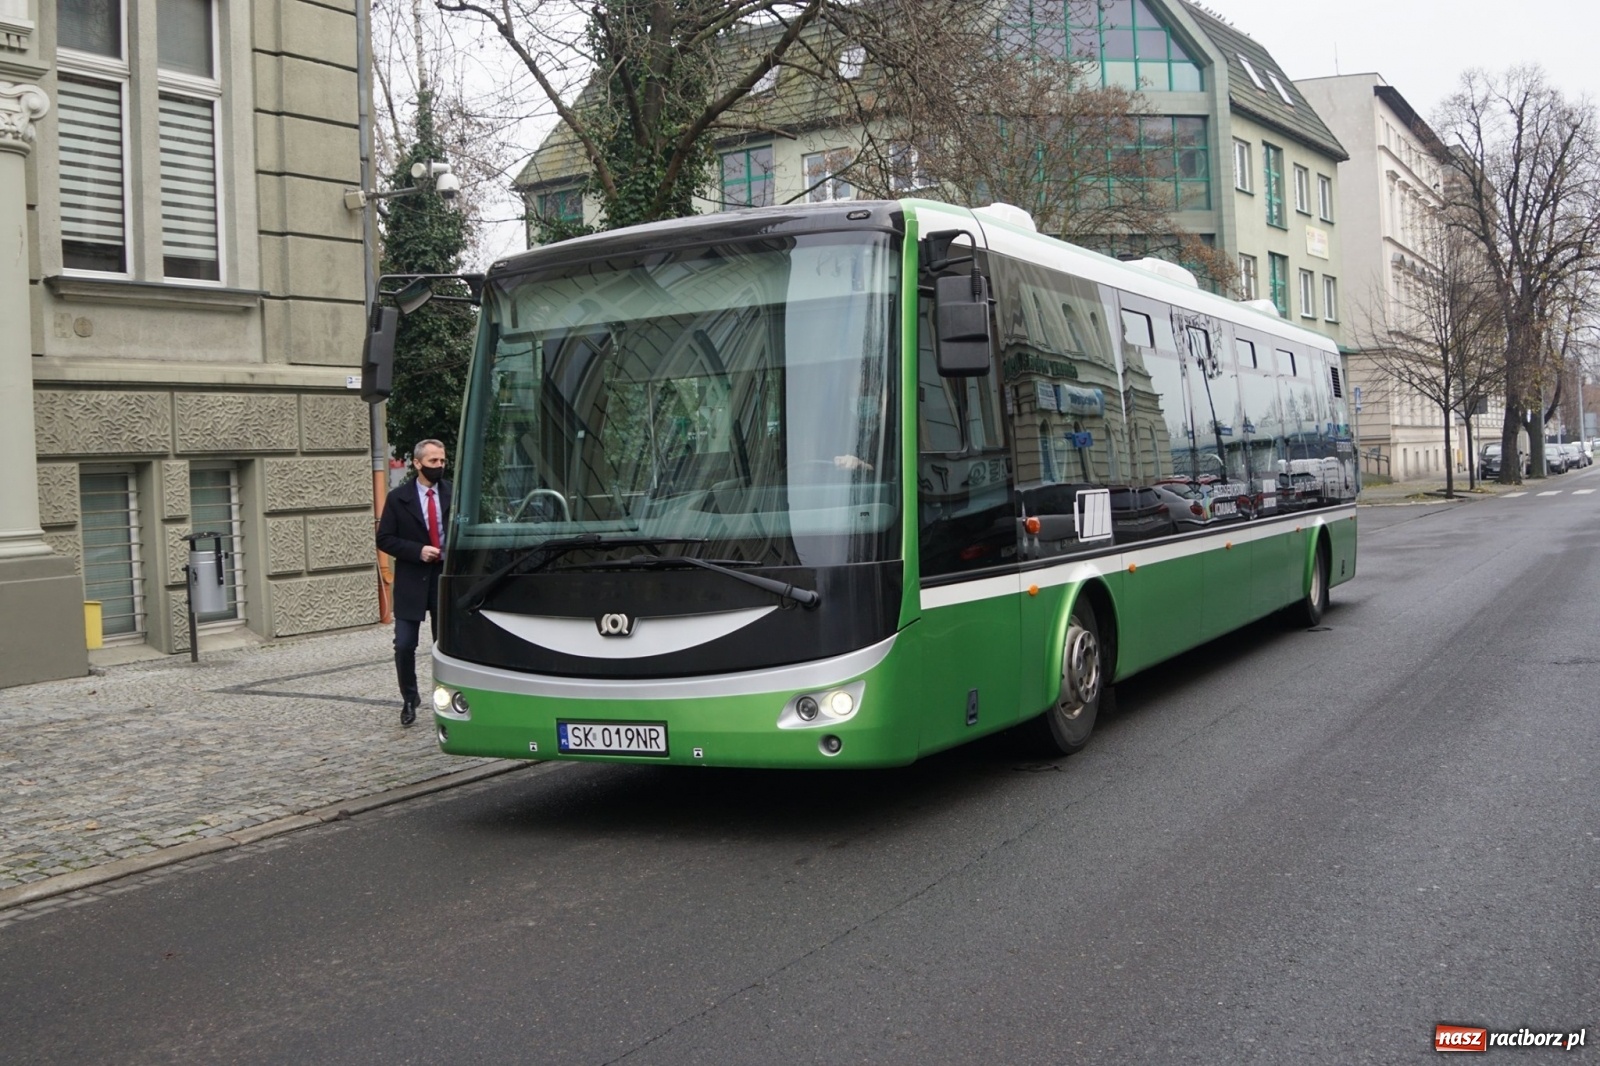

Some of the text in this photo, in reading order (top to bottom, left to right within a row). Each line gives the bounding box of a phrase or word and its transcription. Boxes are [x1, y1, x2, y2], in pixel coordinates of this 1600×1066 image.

[561, 738, 569, 746] PL
[571, 726, 661, 750] SK 019NR
